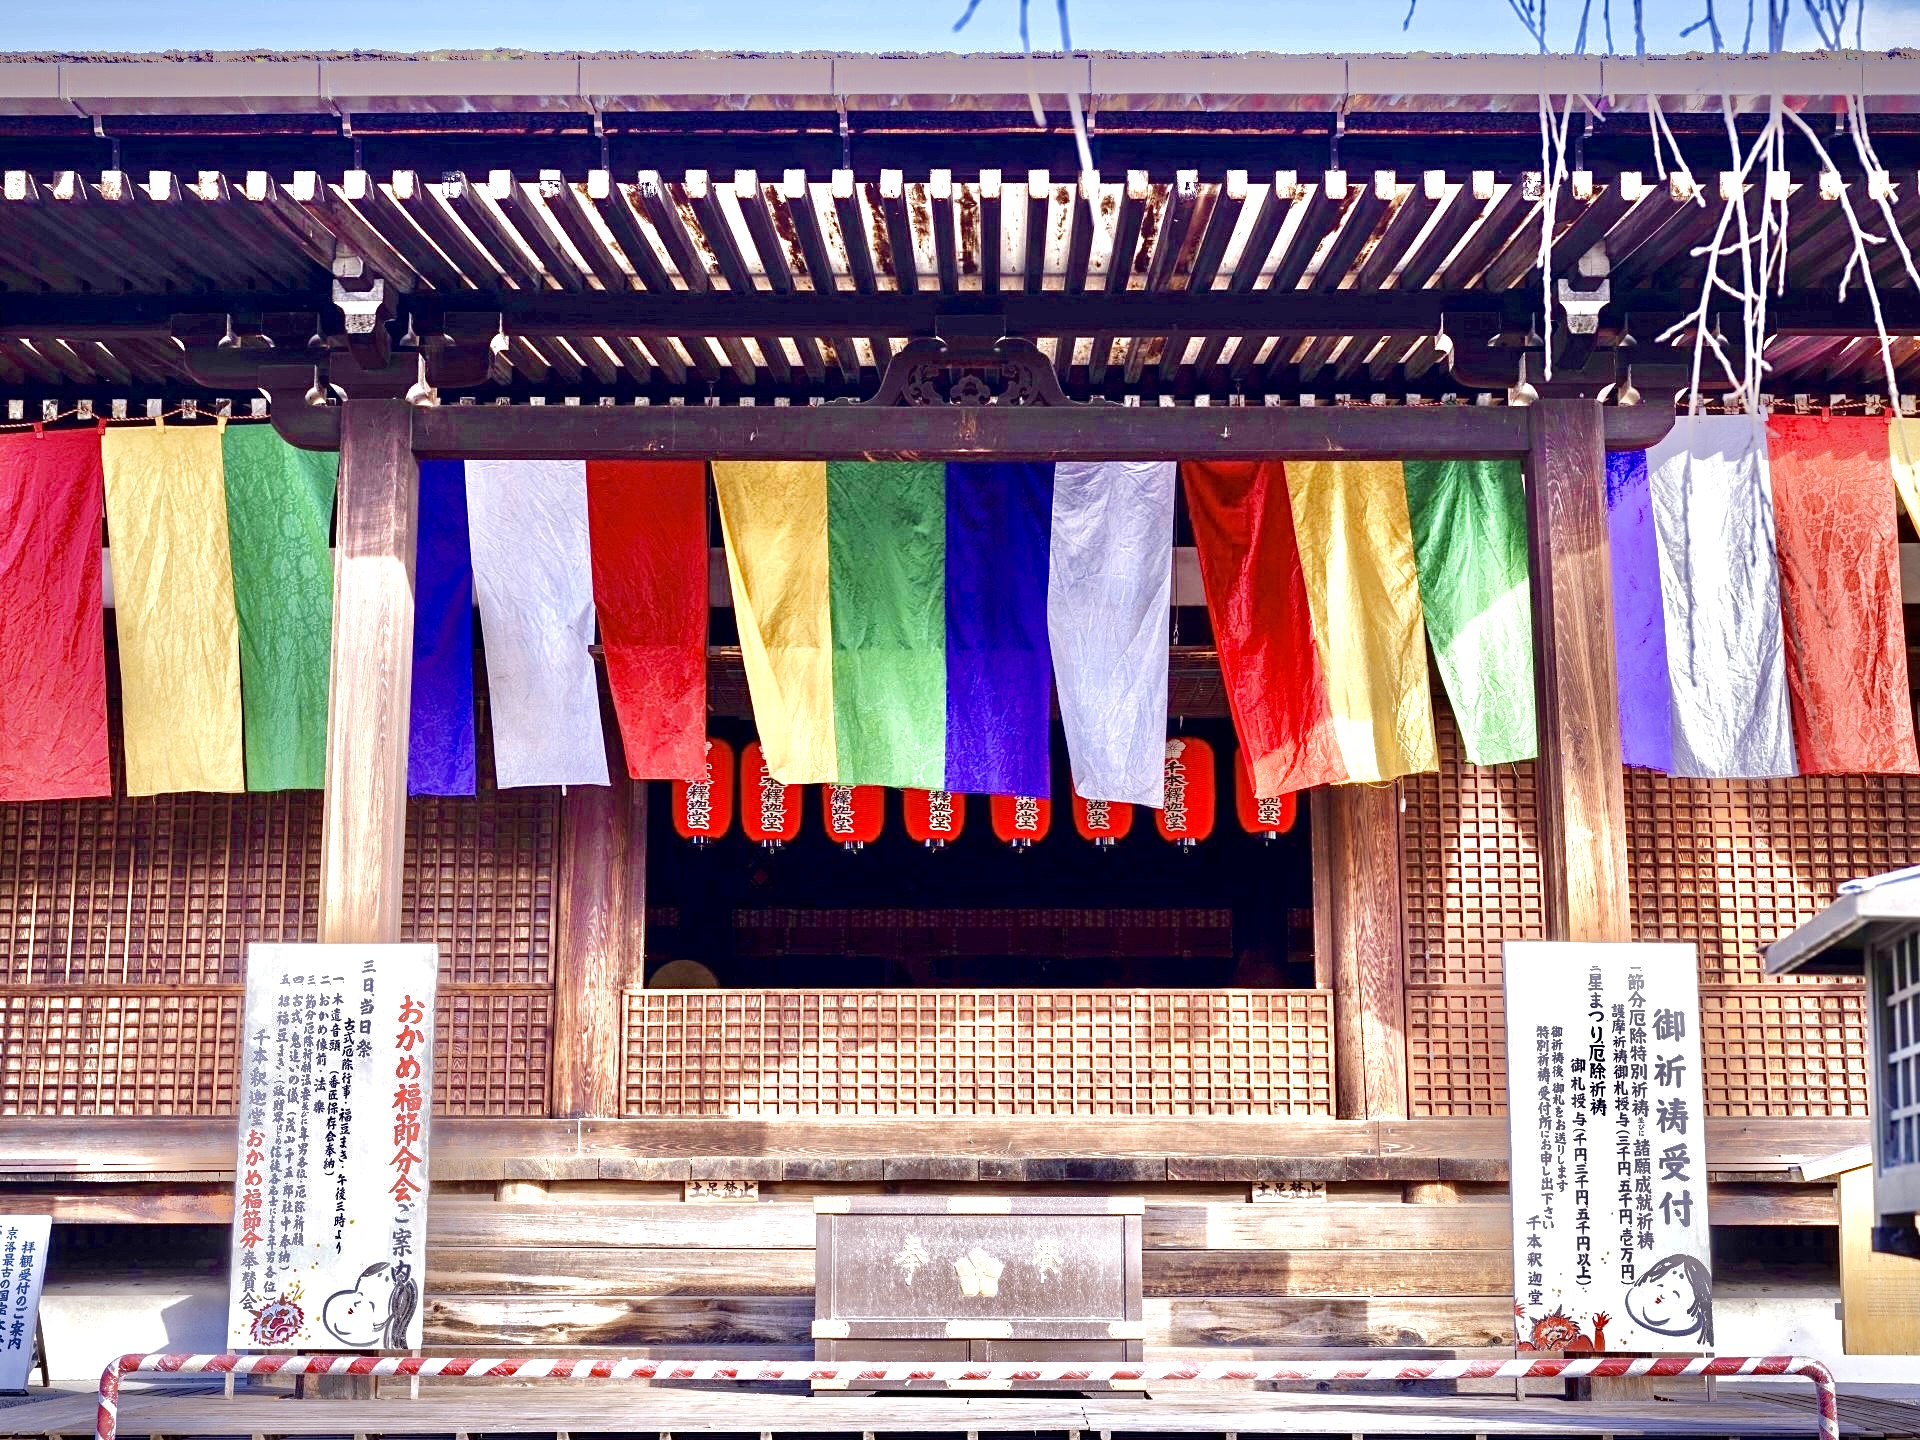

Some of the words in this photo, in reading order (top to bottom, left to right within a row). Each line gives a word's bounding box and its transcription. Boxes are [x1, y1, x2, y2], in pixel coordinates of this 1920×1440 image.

[1164, 759, 1187, 832] 千本釋迦堂
[388, 995, 425, 1283] おかめ福節分会ご案内
[1652, 1008, 1694, 1228] 御祈祷受付
[689, 1181, 754, 1199] 土足禁止
[1256, 1181, 1323, 1199] 土足禁止
[8, 1240, 36, 1350] 拝観受付のご案内
[1526, 1215, 1544, 1305] 千本釈迦堂
